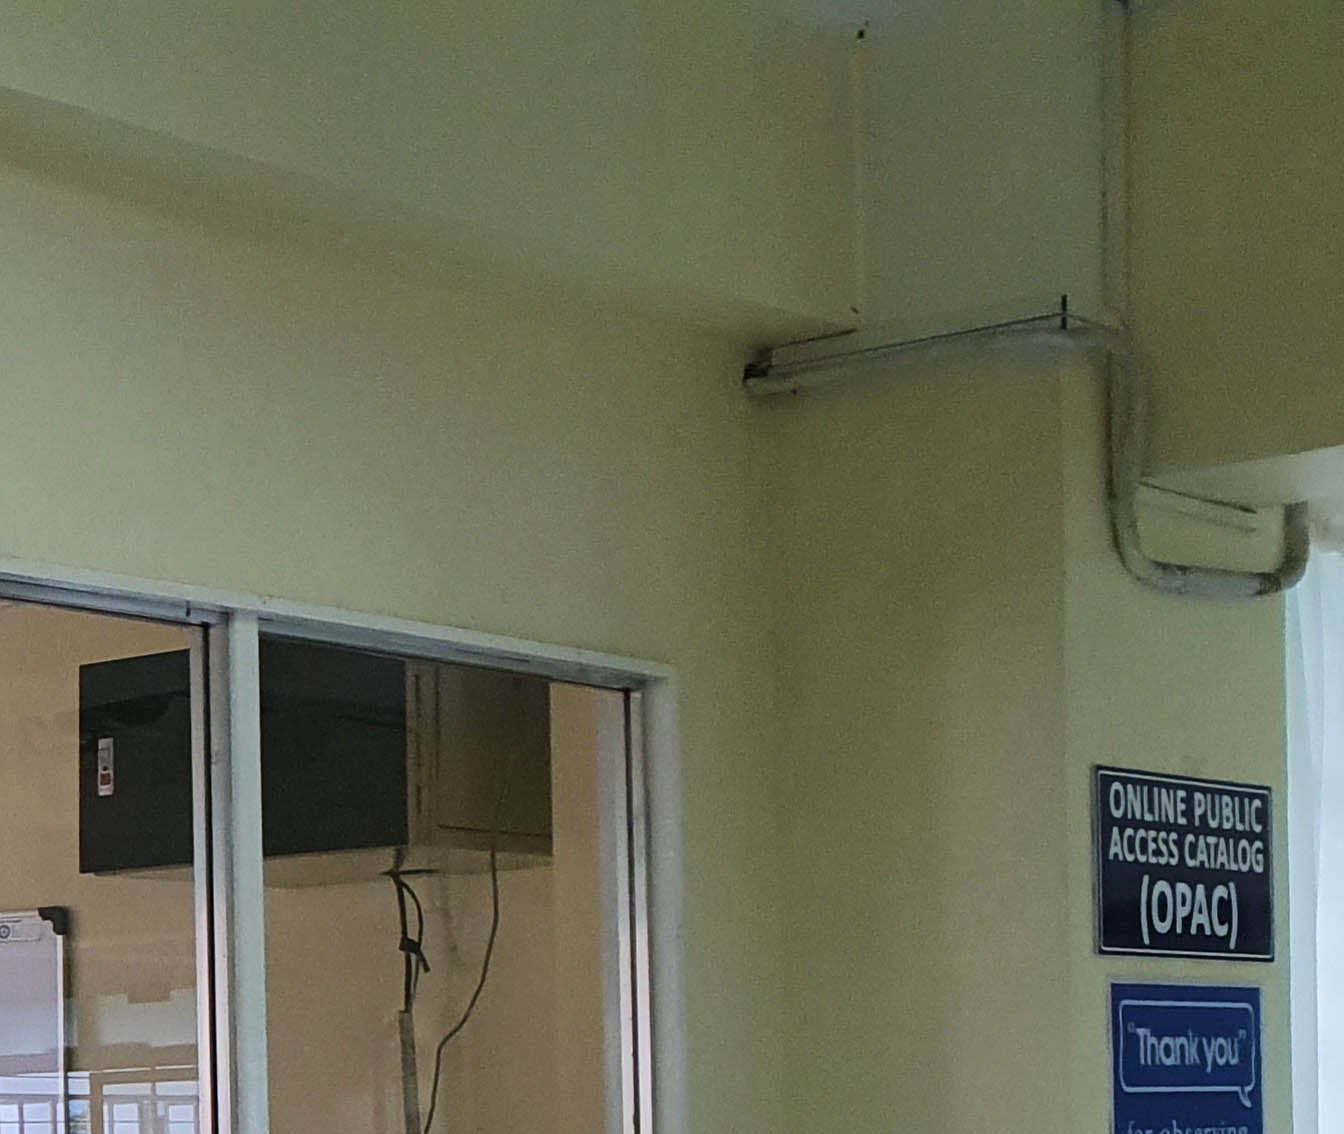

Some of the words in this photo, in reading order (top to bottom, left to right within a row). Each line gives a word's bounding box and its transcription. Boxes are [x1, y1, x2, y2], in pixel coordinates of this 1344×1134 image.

[1109, 781, 1188, 825] ONLINE
[1193, 792, 1263, 833] PUBLIC
[1109, 826, 1179, 865] ACCESS
[1184, 833, 1264, 873] CATALOG
[1140, 875, 1238, 949] (OPAC)
